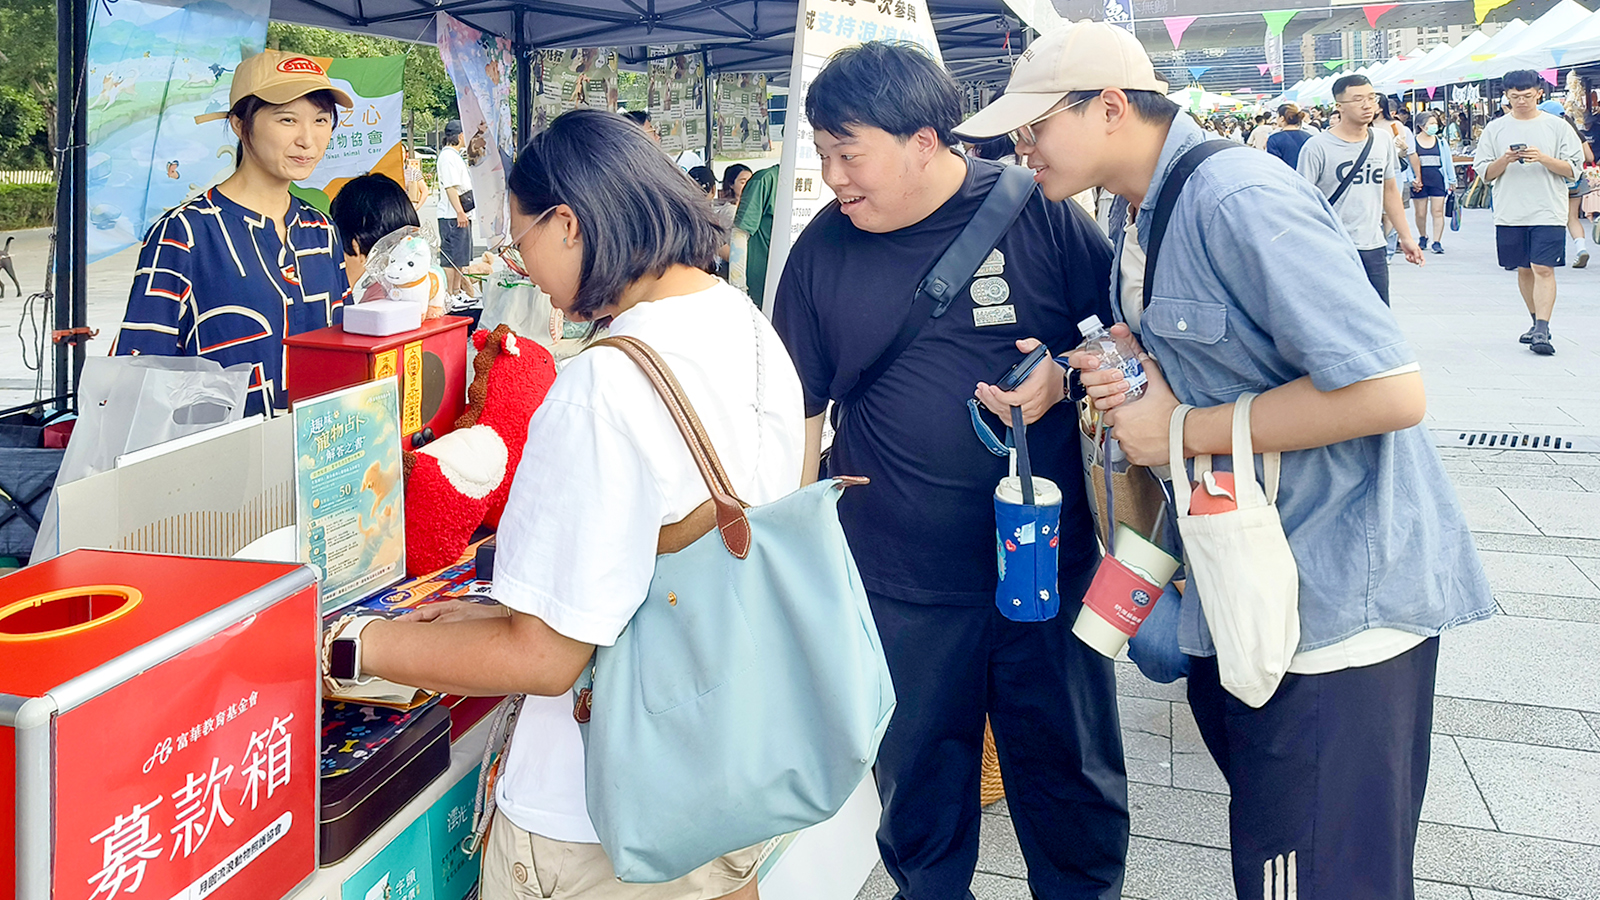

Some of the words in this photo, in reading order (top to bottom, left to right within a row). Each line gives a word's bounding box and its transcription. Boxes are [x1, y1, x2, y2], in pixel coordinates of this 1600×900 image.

[307, 411, 333, 442] 趣味
[314, 411, 366, 458] 寵物占卜
[339, 482, 352, 499] 50
[176, 690, 259, 752] 富華教育基金會
[86, 711, 295, 900] 募款箱
